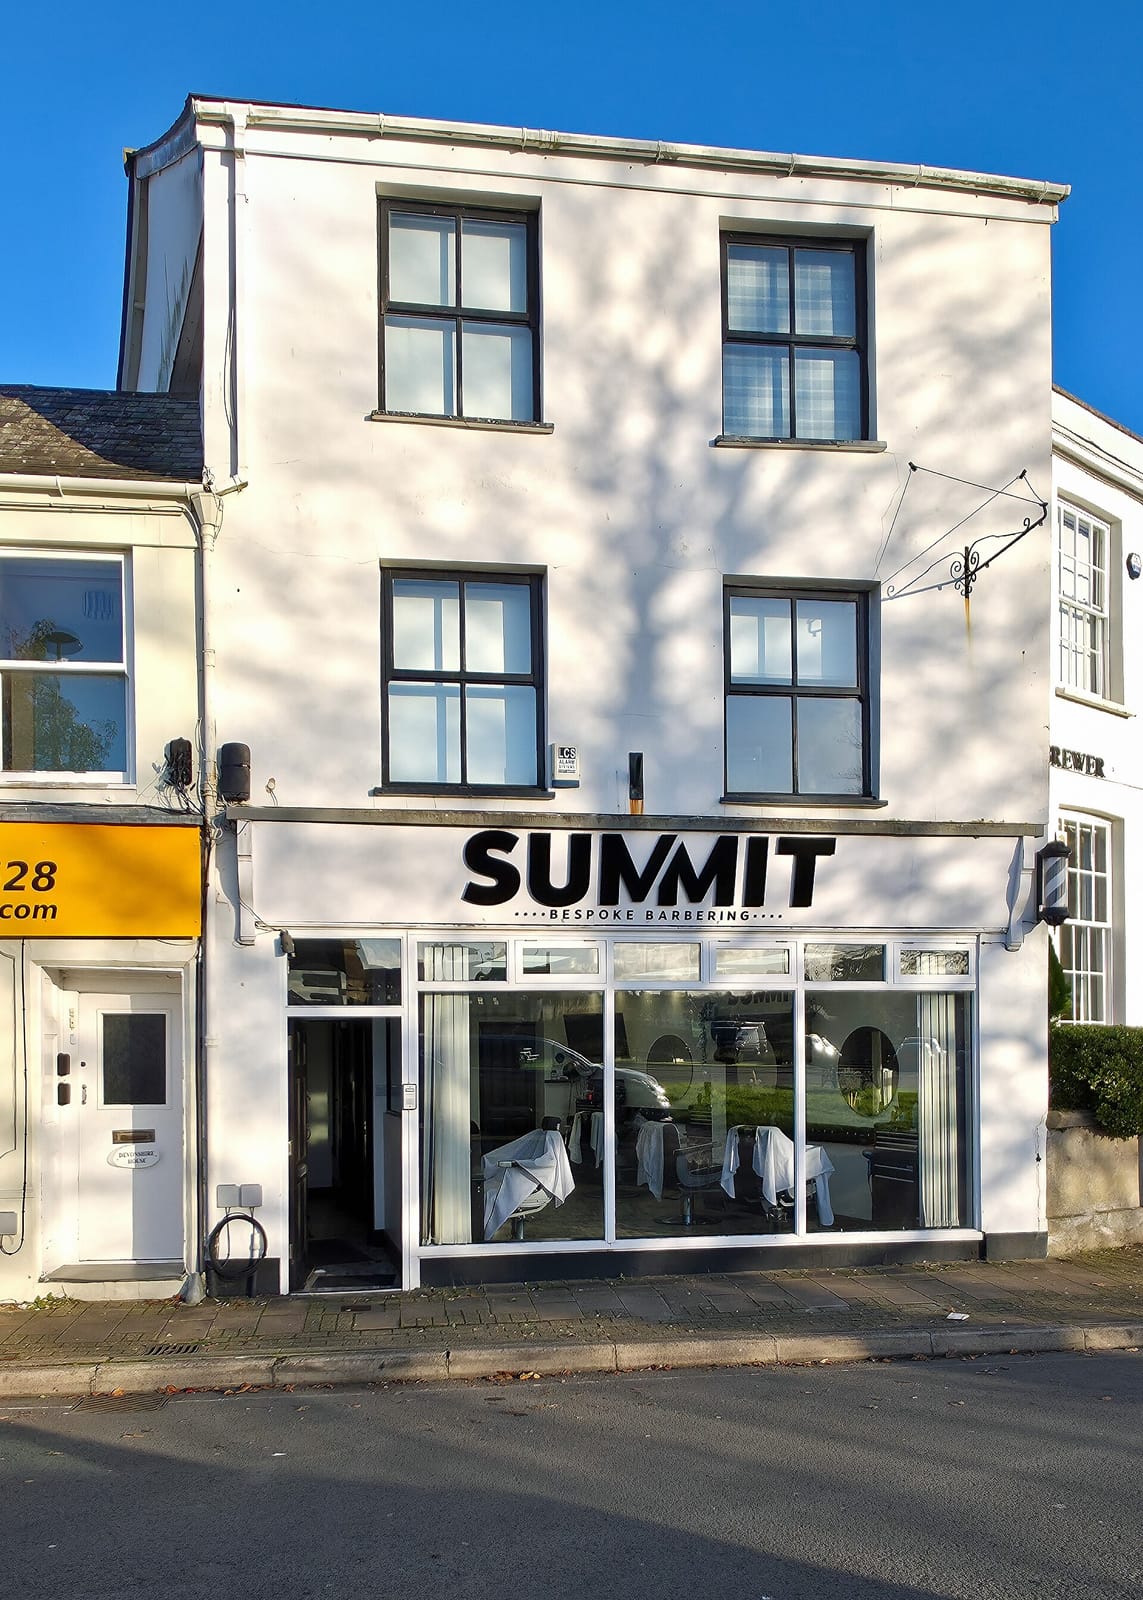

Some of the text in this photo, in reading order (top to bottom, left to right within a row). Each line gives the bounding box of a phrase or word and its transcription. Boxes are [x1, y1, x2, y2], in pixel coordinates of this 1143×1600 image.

[0, 861, 57, 891] 28
[461, 830, 836, 908] SUMMIT
[550, 910, 749, 921] BESPOKE BARBERING
